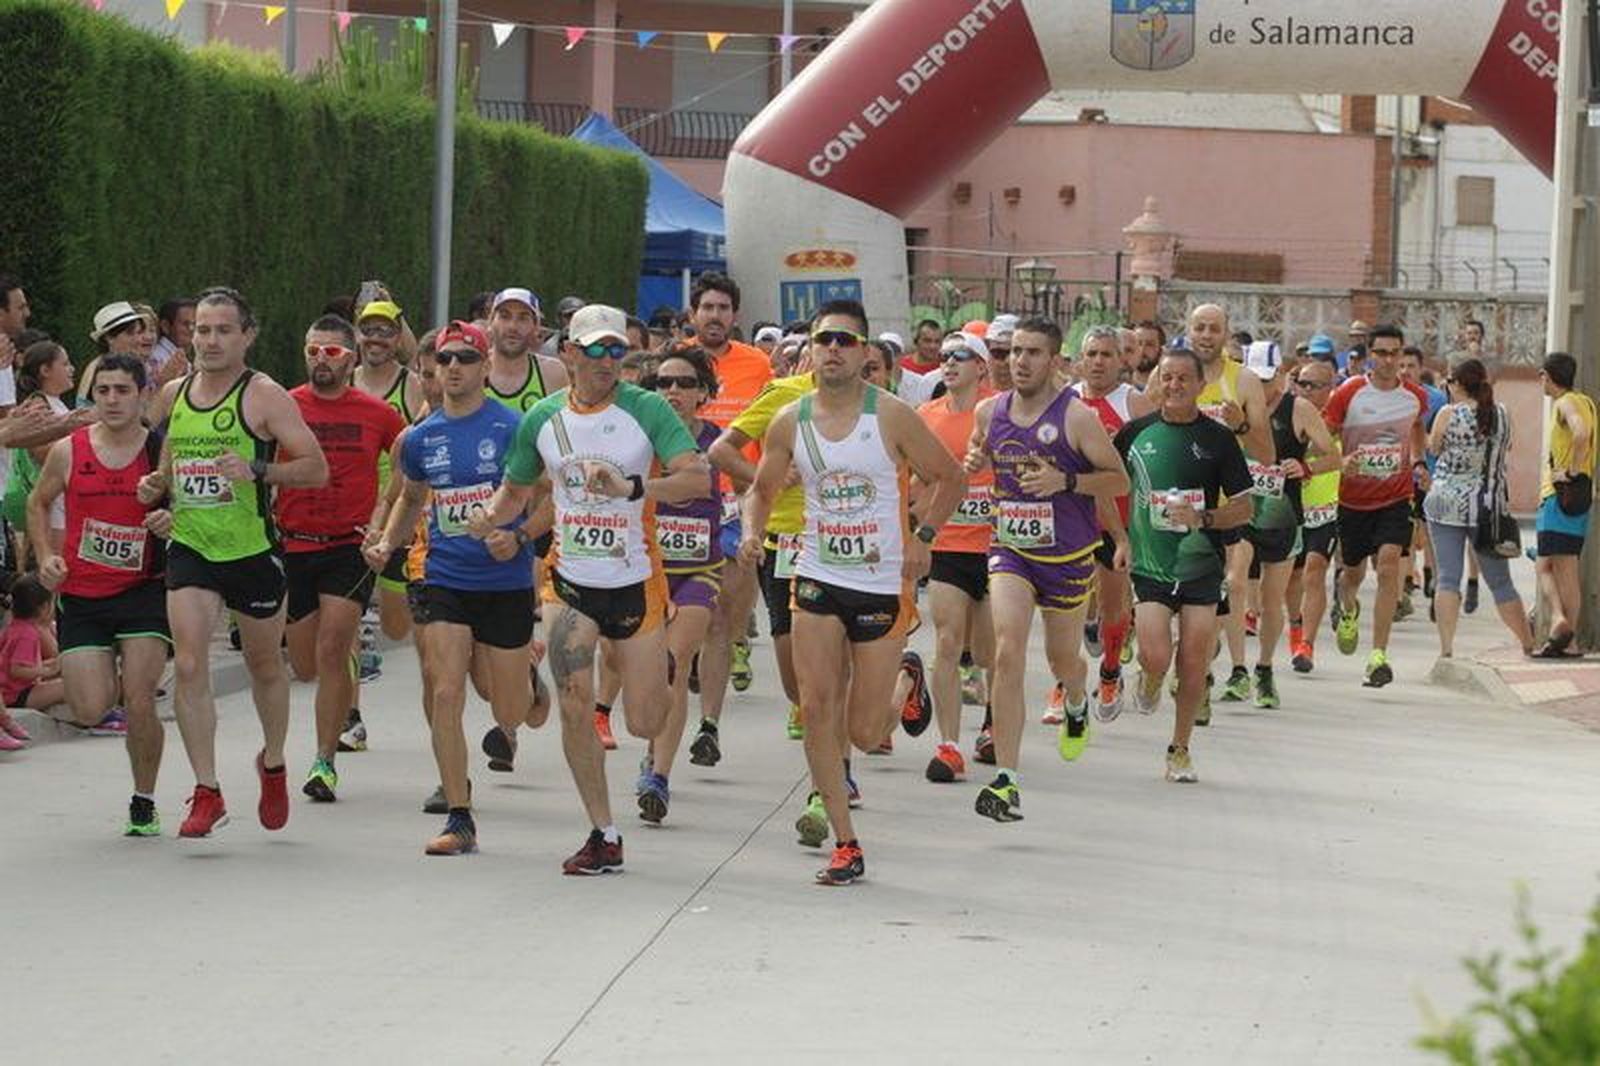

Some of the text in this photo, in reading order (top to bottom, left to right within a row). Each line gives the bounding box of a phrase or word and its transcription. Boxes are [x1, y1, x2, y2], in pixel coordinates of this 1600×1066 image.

[1209, 16, 1414, 45] de Salamanca
[1507, 31, 1559, 93] DEP
[808, 122, 866, 177] CON
[862, 95, 901, 128] EL
[183, 476, 219, 495] 475
[957, 500, 991, 516] 428
[573, 527, 614, 546] 490
[1007, 519, 1041, 537] 448
[93, 537, 132, 559] 305
[660, 532, 697, 554] 485
[828, 536, 865, 555] 401
